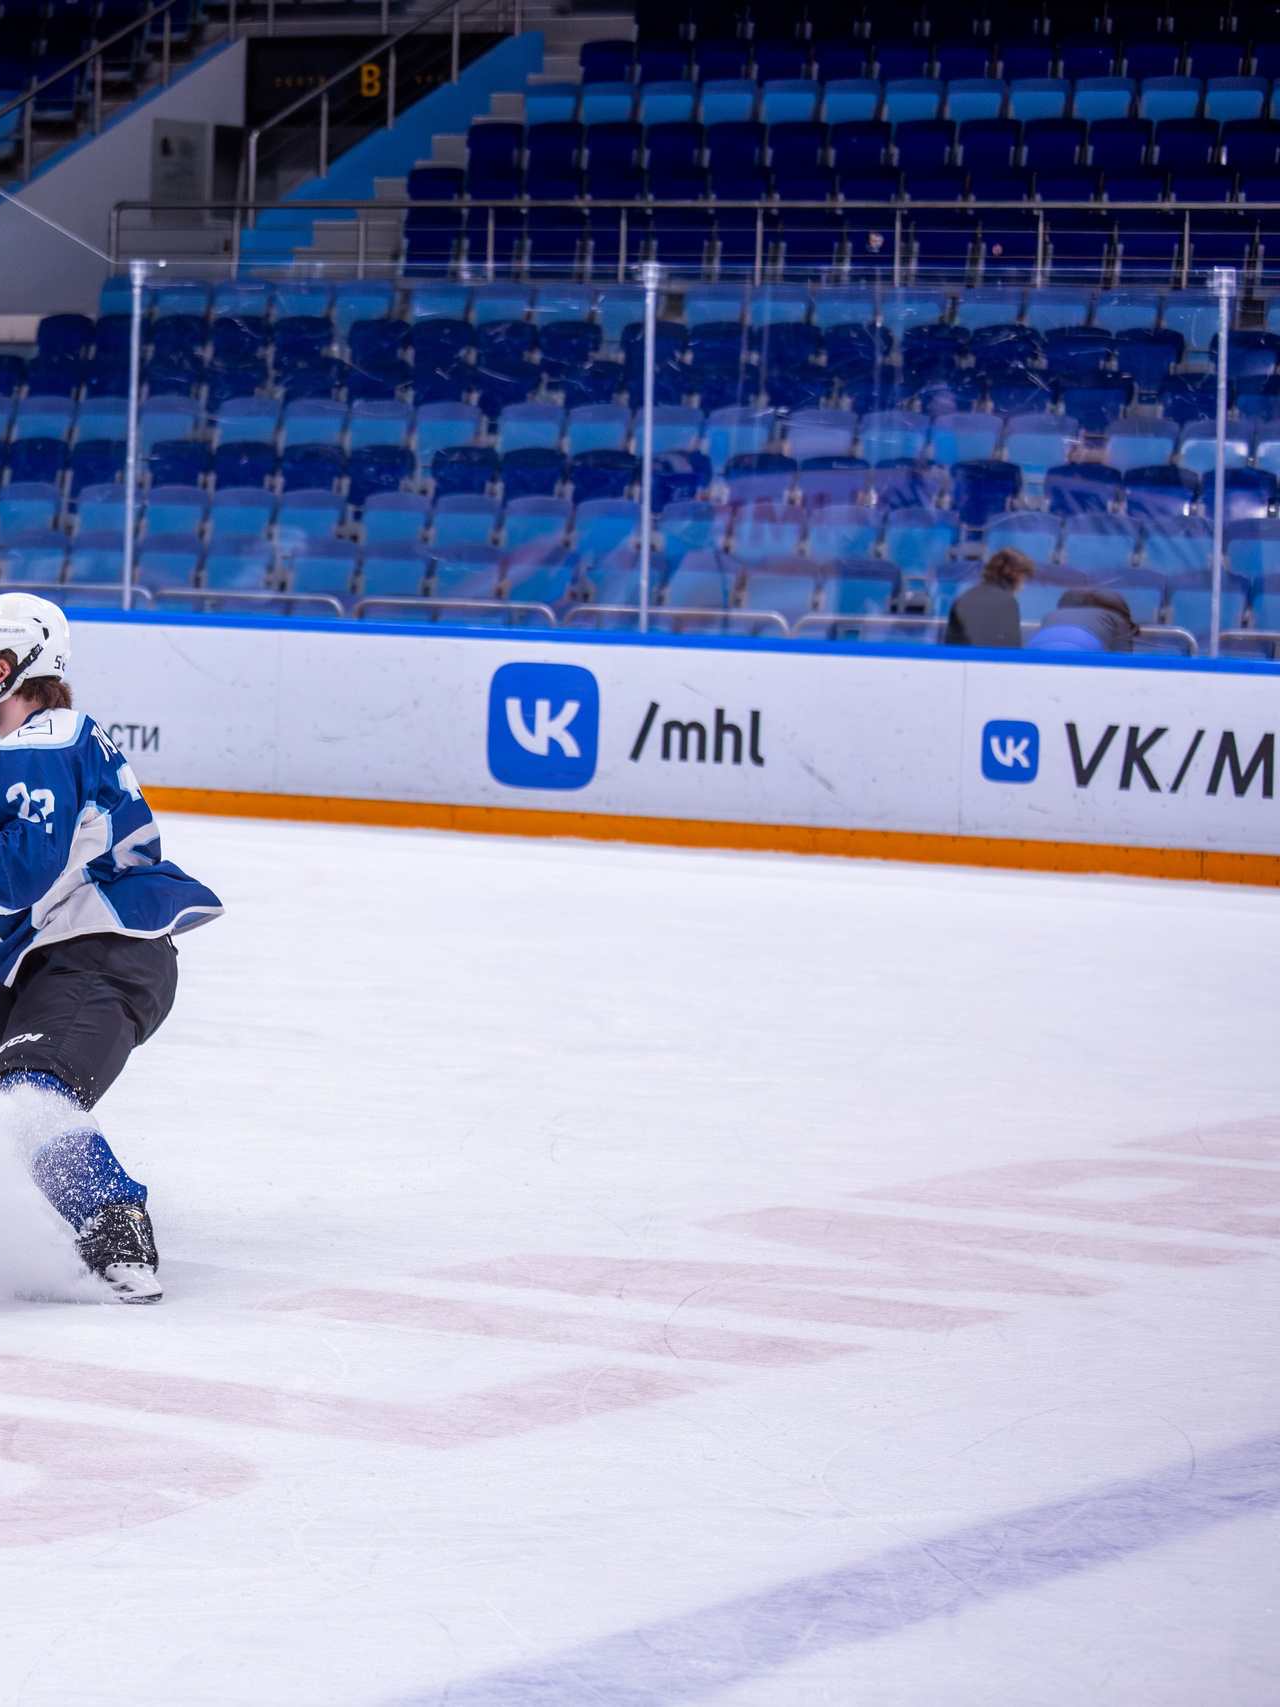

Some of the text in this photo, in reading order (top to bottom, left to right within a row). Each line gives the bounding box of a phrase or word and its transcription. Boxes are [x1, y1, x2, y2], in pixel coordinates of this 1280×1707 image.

[505, 696, 765, 767] VK /mhl
[989, 734, 1031, 769] VK
